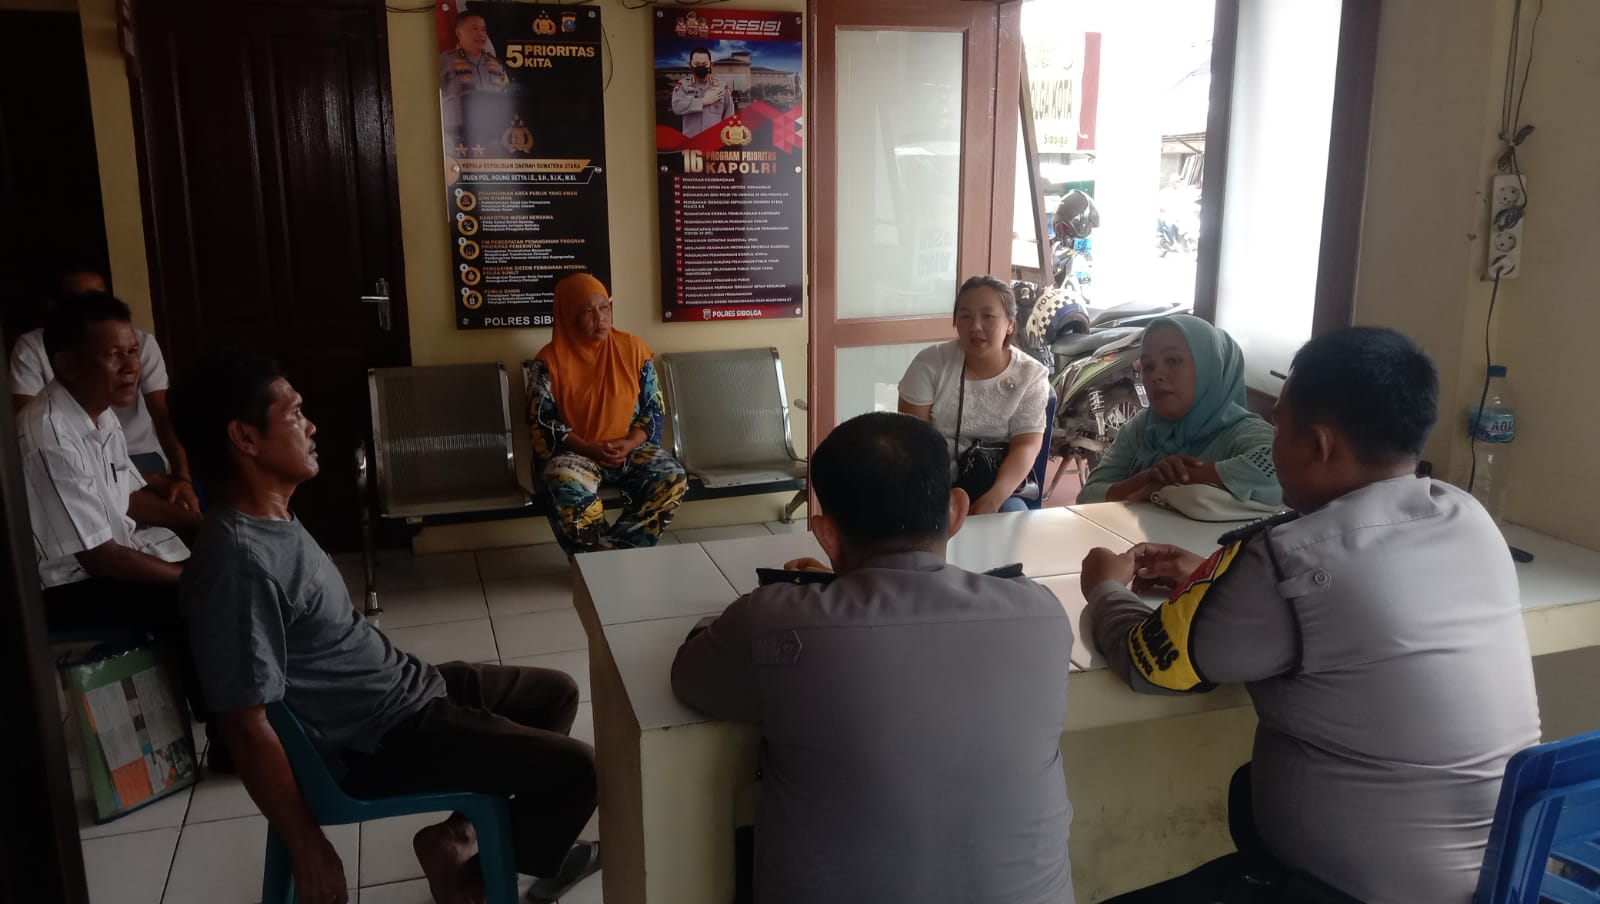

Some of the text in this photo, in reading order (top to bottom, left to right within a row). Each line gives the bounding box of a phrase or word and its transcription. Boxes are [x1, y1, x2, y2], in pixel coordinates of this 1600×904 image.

[711, 19, 781, 31] PRESISI
[506, 45, 595, 68] 5 PRIORITAS
[525, 58, 552, 68] KITA
[1051, 80, 1072, 120] KOTA
[681, 150, 776, 173] 16 PROGRAM PRIORITAS
[705, 162, 776, 174] KAPOLRI
[712, 309, 762, 318] POLRES SIBOLGA
[484, 316, 554, 326] POLRES SIB
